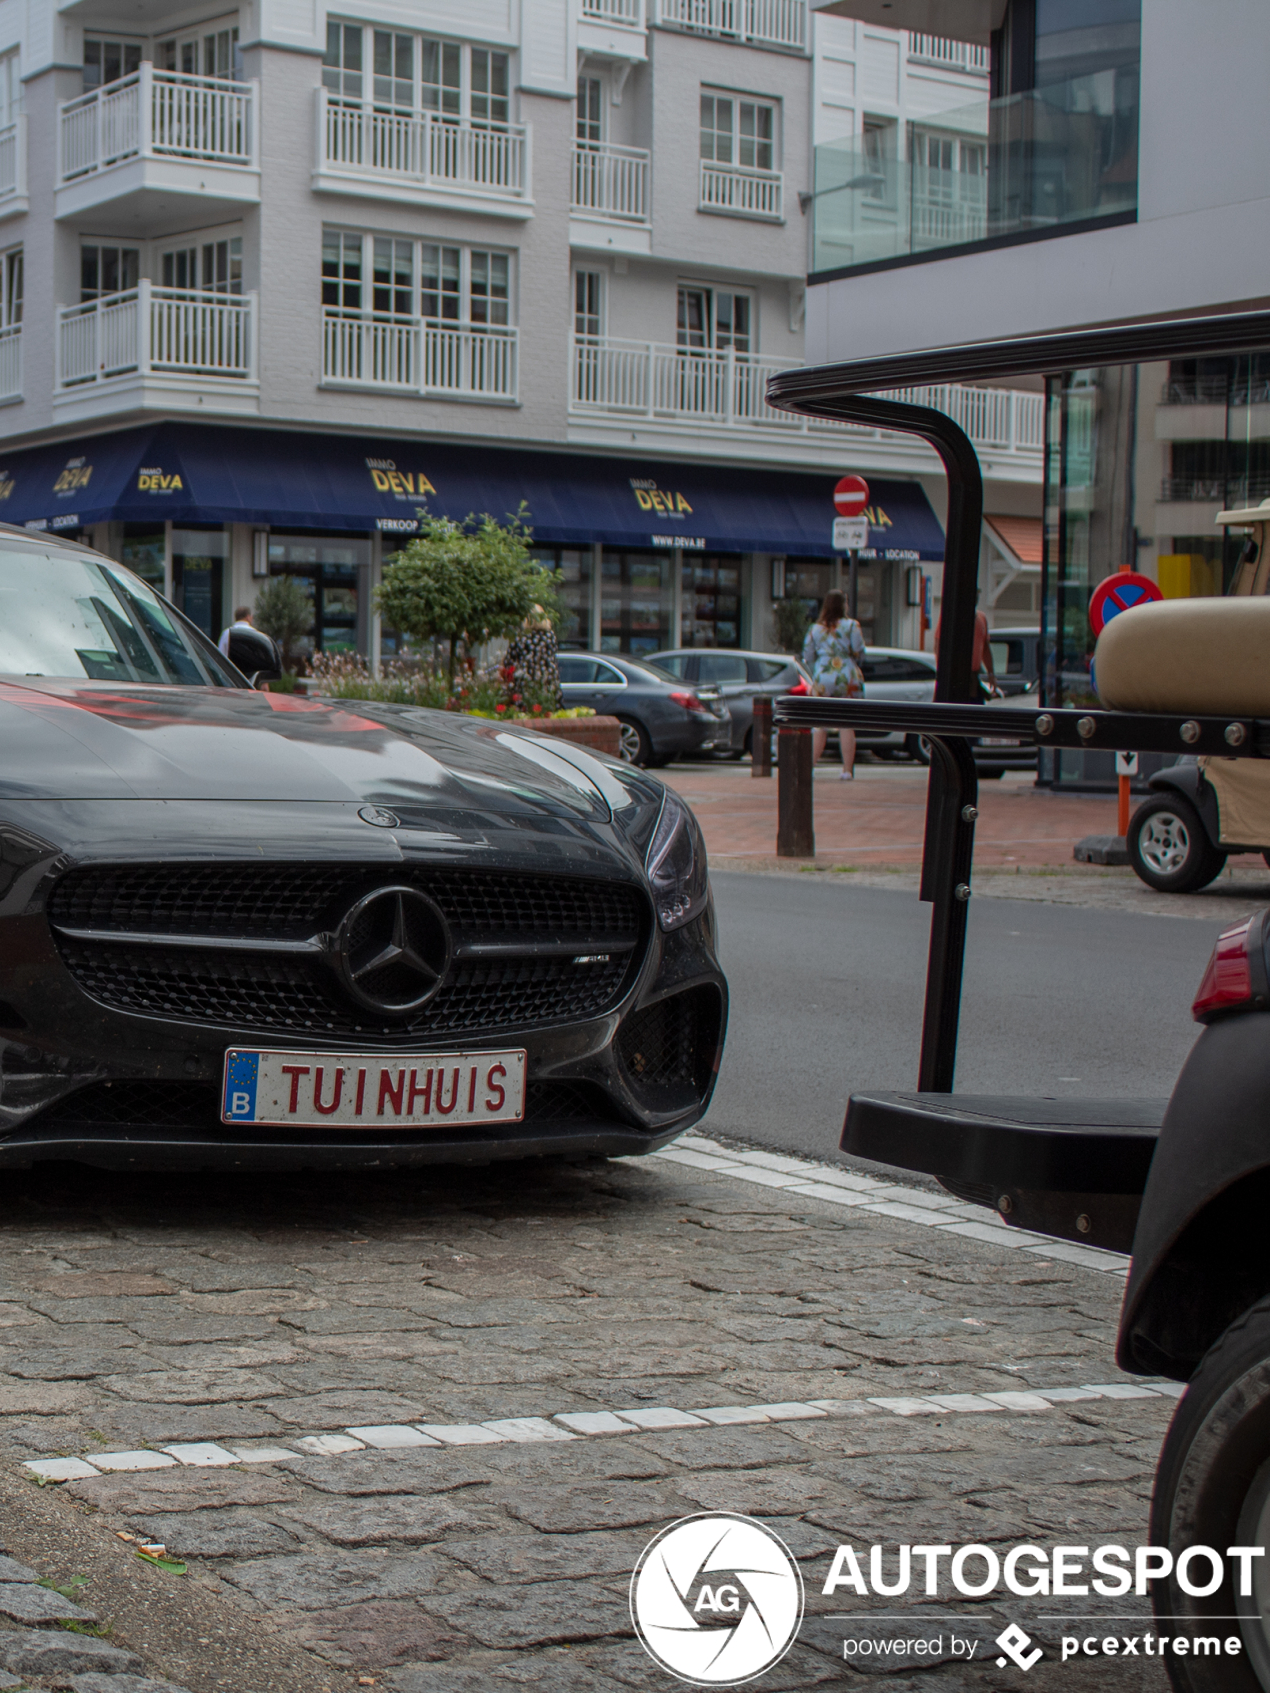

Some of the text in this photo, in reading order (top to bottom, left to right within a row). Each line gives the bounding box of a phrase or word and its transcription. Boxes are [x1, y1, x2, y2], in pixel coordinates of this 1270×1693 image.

[140, 467, 162, 475] IMMO
[366, 458, 396, 470] IMMO
[53, 465, 94, 492] DEVA
[138, 474, 183, 491] DEVA
[371, 468, 437, 495] DEVA
[635, 489, 694, 515] DEVA
[376, 518, 419, 531] VERKOOP
[651, 534, 706, 550] WWW.DEVA.BE
[885, 549, 920, 561] LOCATION
[232, 1063, 507, 1116] B TUINHUIS
